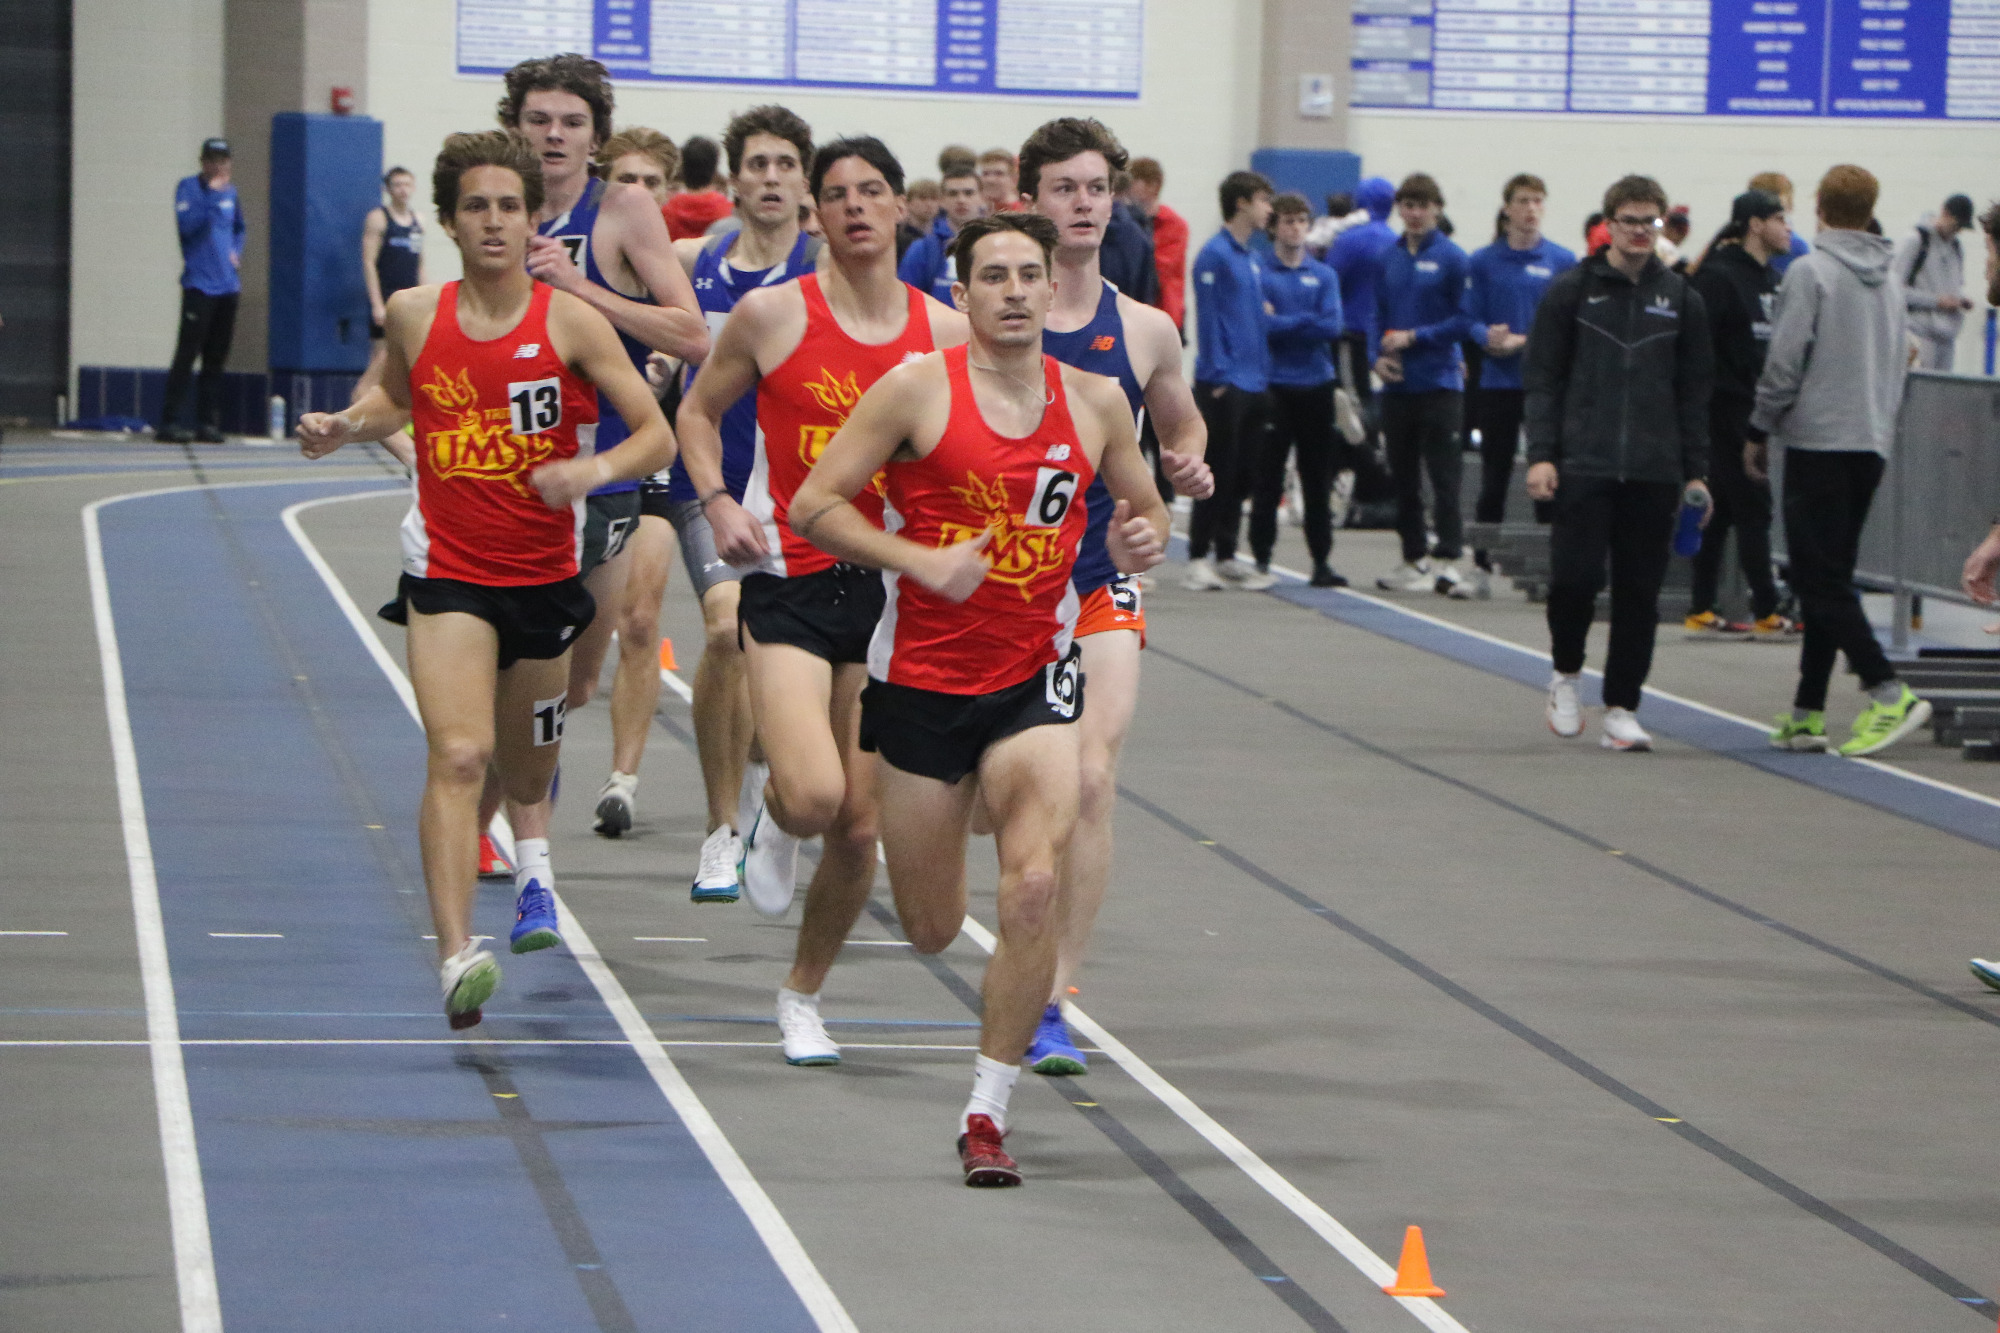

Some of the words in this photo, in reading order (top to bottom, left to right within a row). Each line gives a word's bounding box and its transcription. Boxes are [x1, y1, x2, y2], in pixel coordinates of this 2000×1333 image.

[511, 385, 558, 432] 13
[1040, 471, 1075, 524] 6
[1053, 657, 1077, 705] 6
